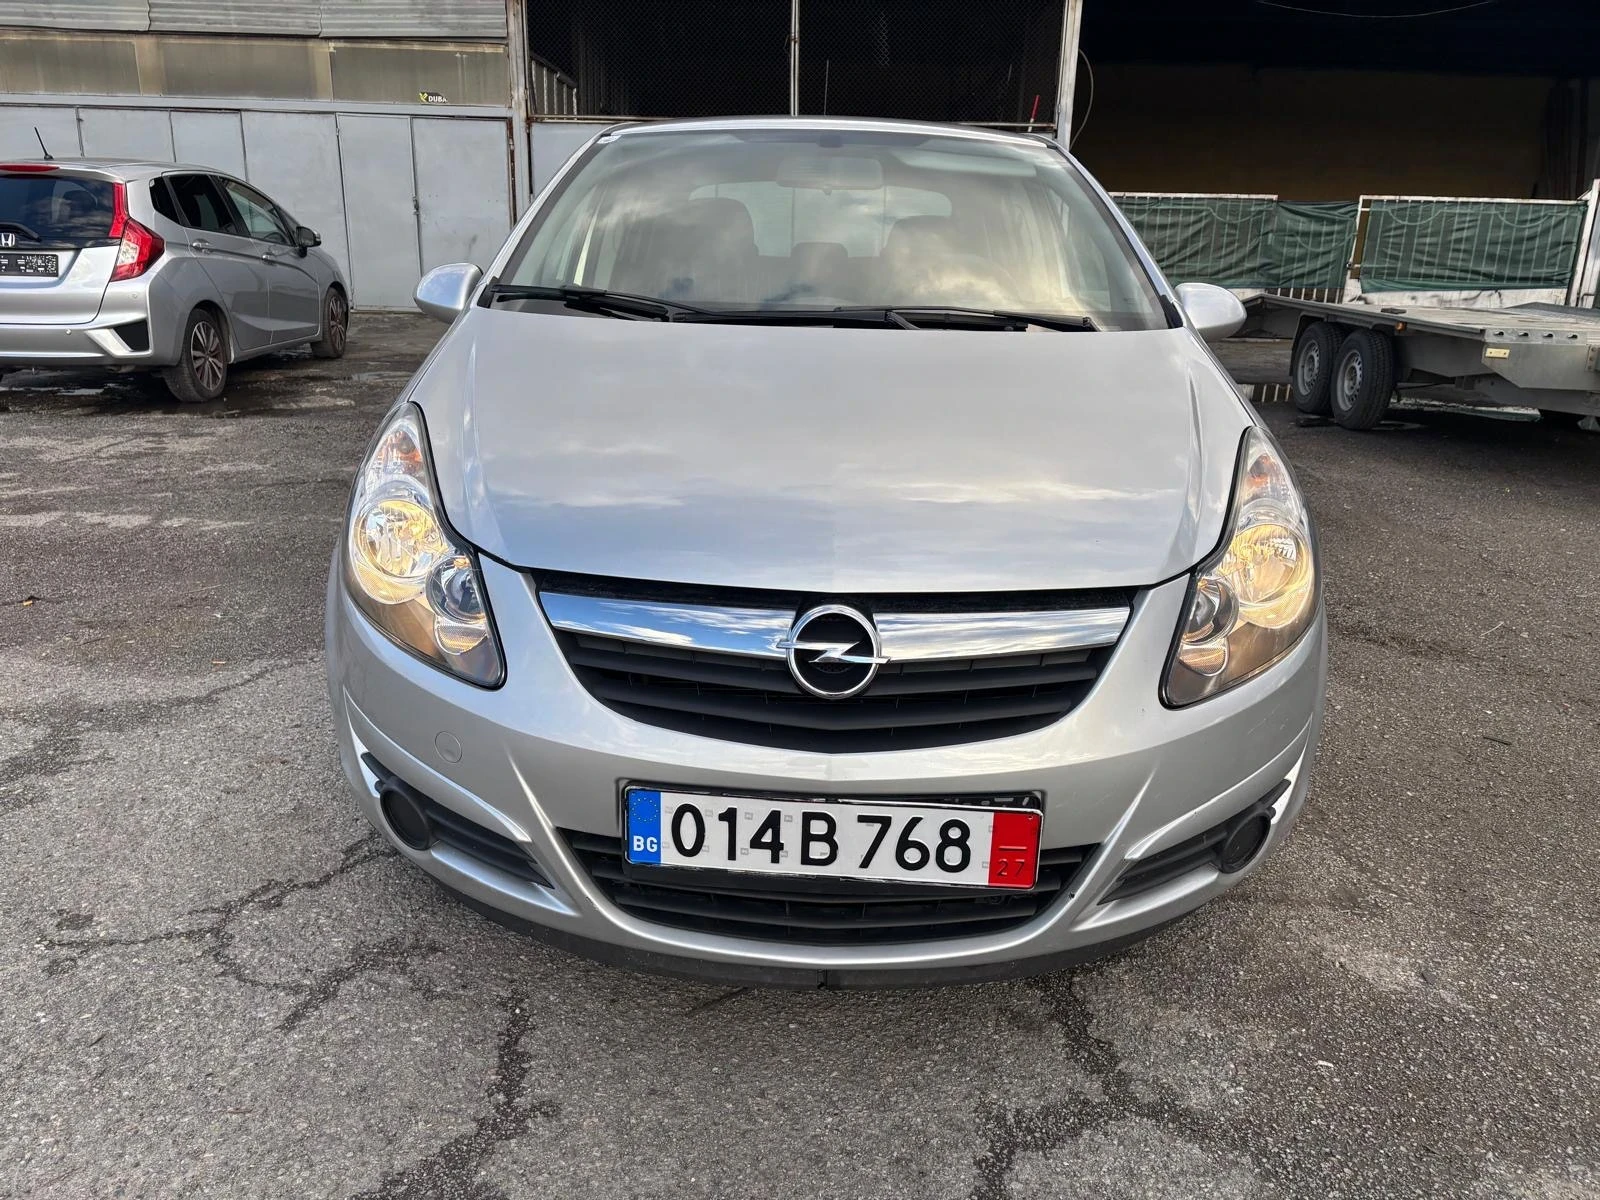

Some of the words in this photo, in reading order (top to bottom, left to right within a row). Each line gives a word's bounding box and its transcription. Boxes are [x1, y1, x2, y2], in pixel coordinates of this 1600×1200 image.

[633, 835, 658, 853] BG
[671, 803, 784, 864] 014
[800, 811, 839, 867] B
[857, 814, 971, 873] 768
[997, 858, 1025, 877] 27
